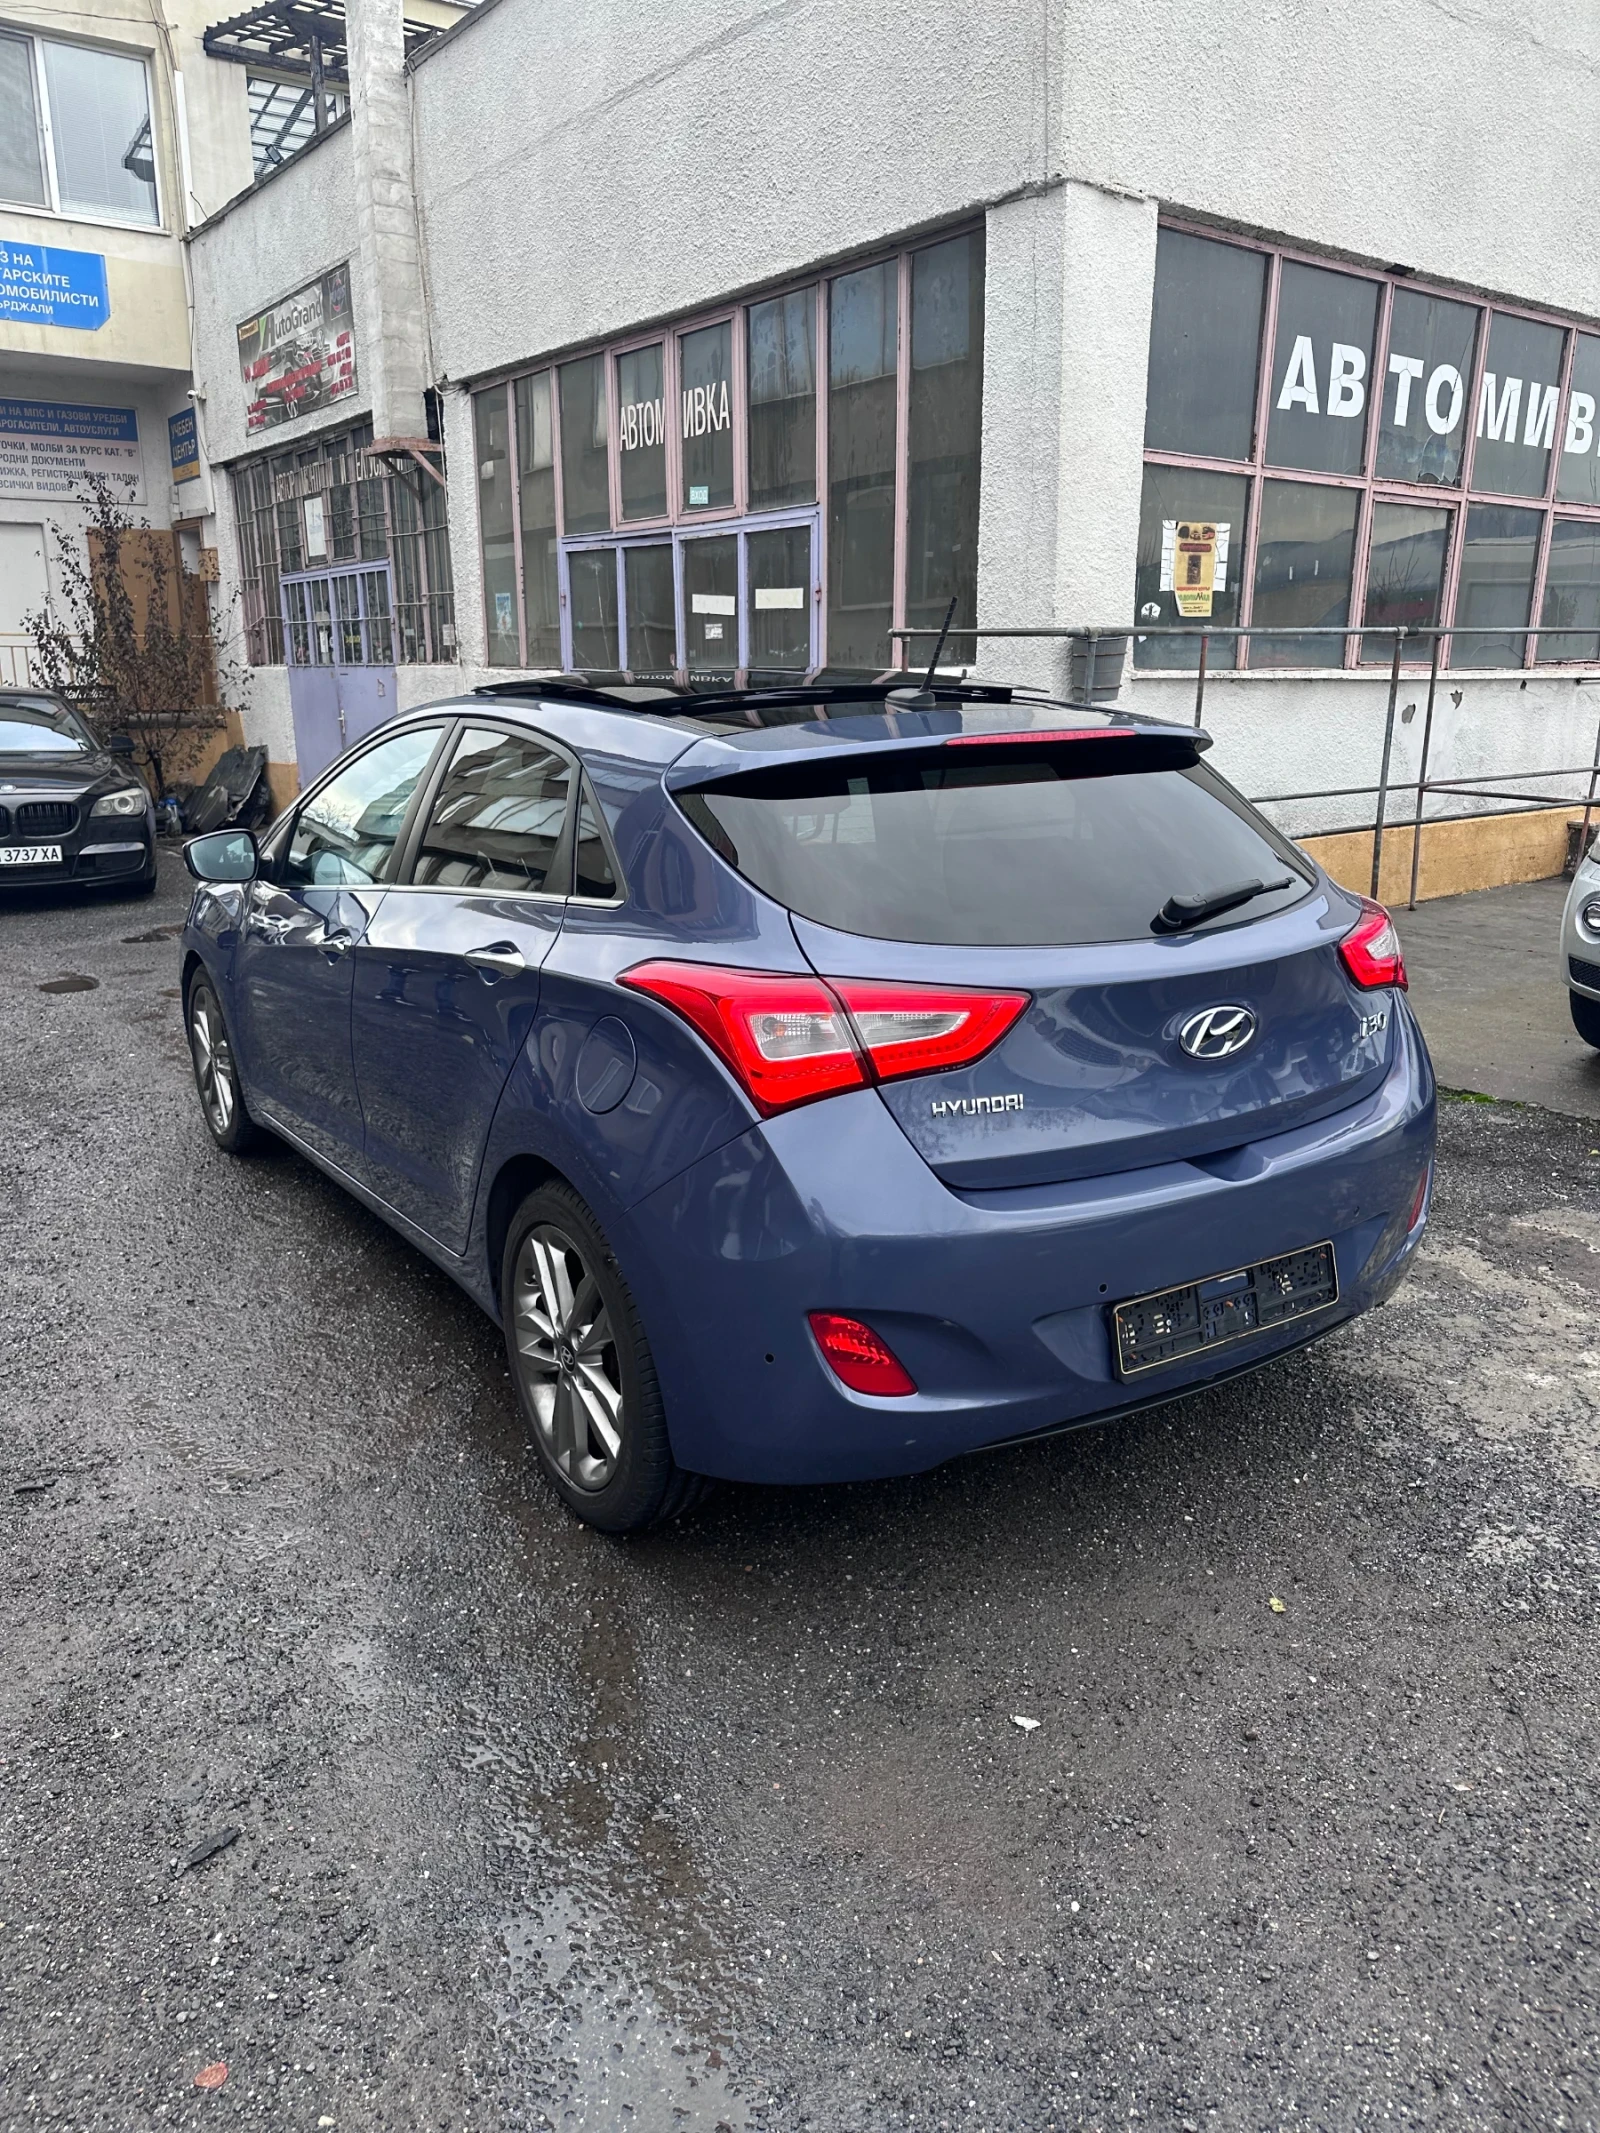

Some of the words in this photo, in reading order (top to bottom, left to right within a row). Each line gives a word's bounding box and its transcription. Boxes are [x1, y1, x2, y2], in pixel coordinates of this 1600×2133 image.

[13, 252, 34, 267] НА
[0, 267, 70, 288] АРСКИТЕ
[261, 296, 323, 352] AutoGrand
[9, 406, 21, 416] НА
[24, 407, 45, 418] МПС
[47, 409, 54, 419] И
[57, 410, 91, 422] ГАЗОВИ
[92, 412, 127, 425] УРЕДБИ
[0, 418, 62, 433] РОГАСИТЕЛИ,
[64, 423, 119, 436] АВТОУСЛУГИ
[170, 416, 194, 440] УЧЕБЕН
[0, 440, 28, 452] ОЧКИ,
[30, 442, 64, 453] МОЛБИ
[66, 444, 78, 454] ЗА
[80, 445, 102, 456] КУРС
[104, 447, 122, 457] КАТ.
[172, 438, 196, 463] ЦЕНТЪР
[31, 455, 86, 468] ДОКУМЕНТИ
[36, 481, 73, 493] ВИДОВЕ
[4, 848, 38, 862] 3737
[1360, 1010, 1387, 1039] i30
[931, 1093, 1024, 1118] HYUNDAI
